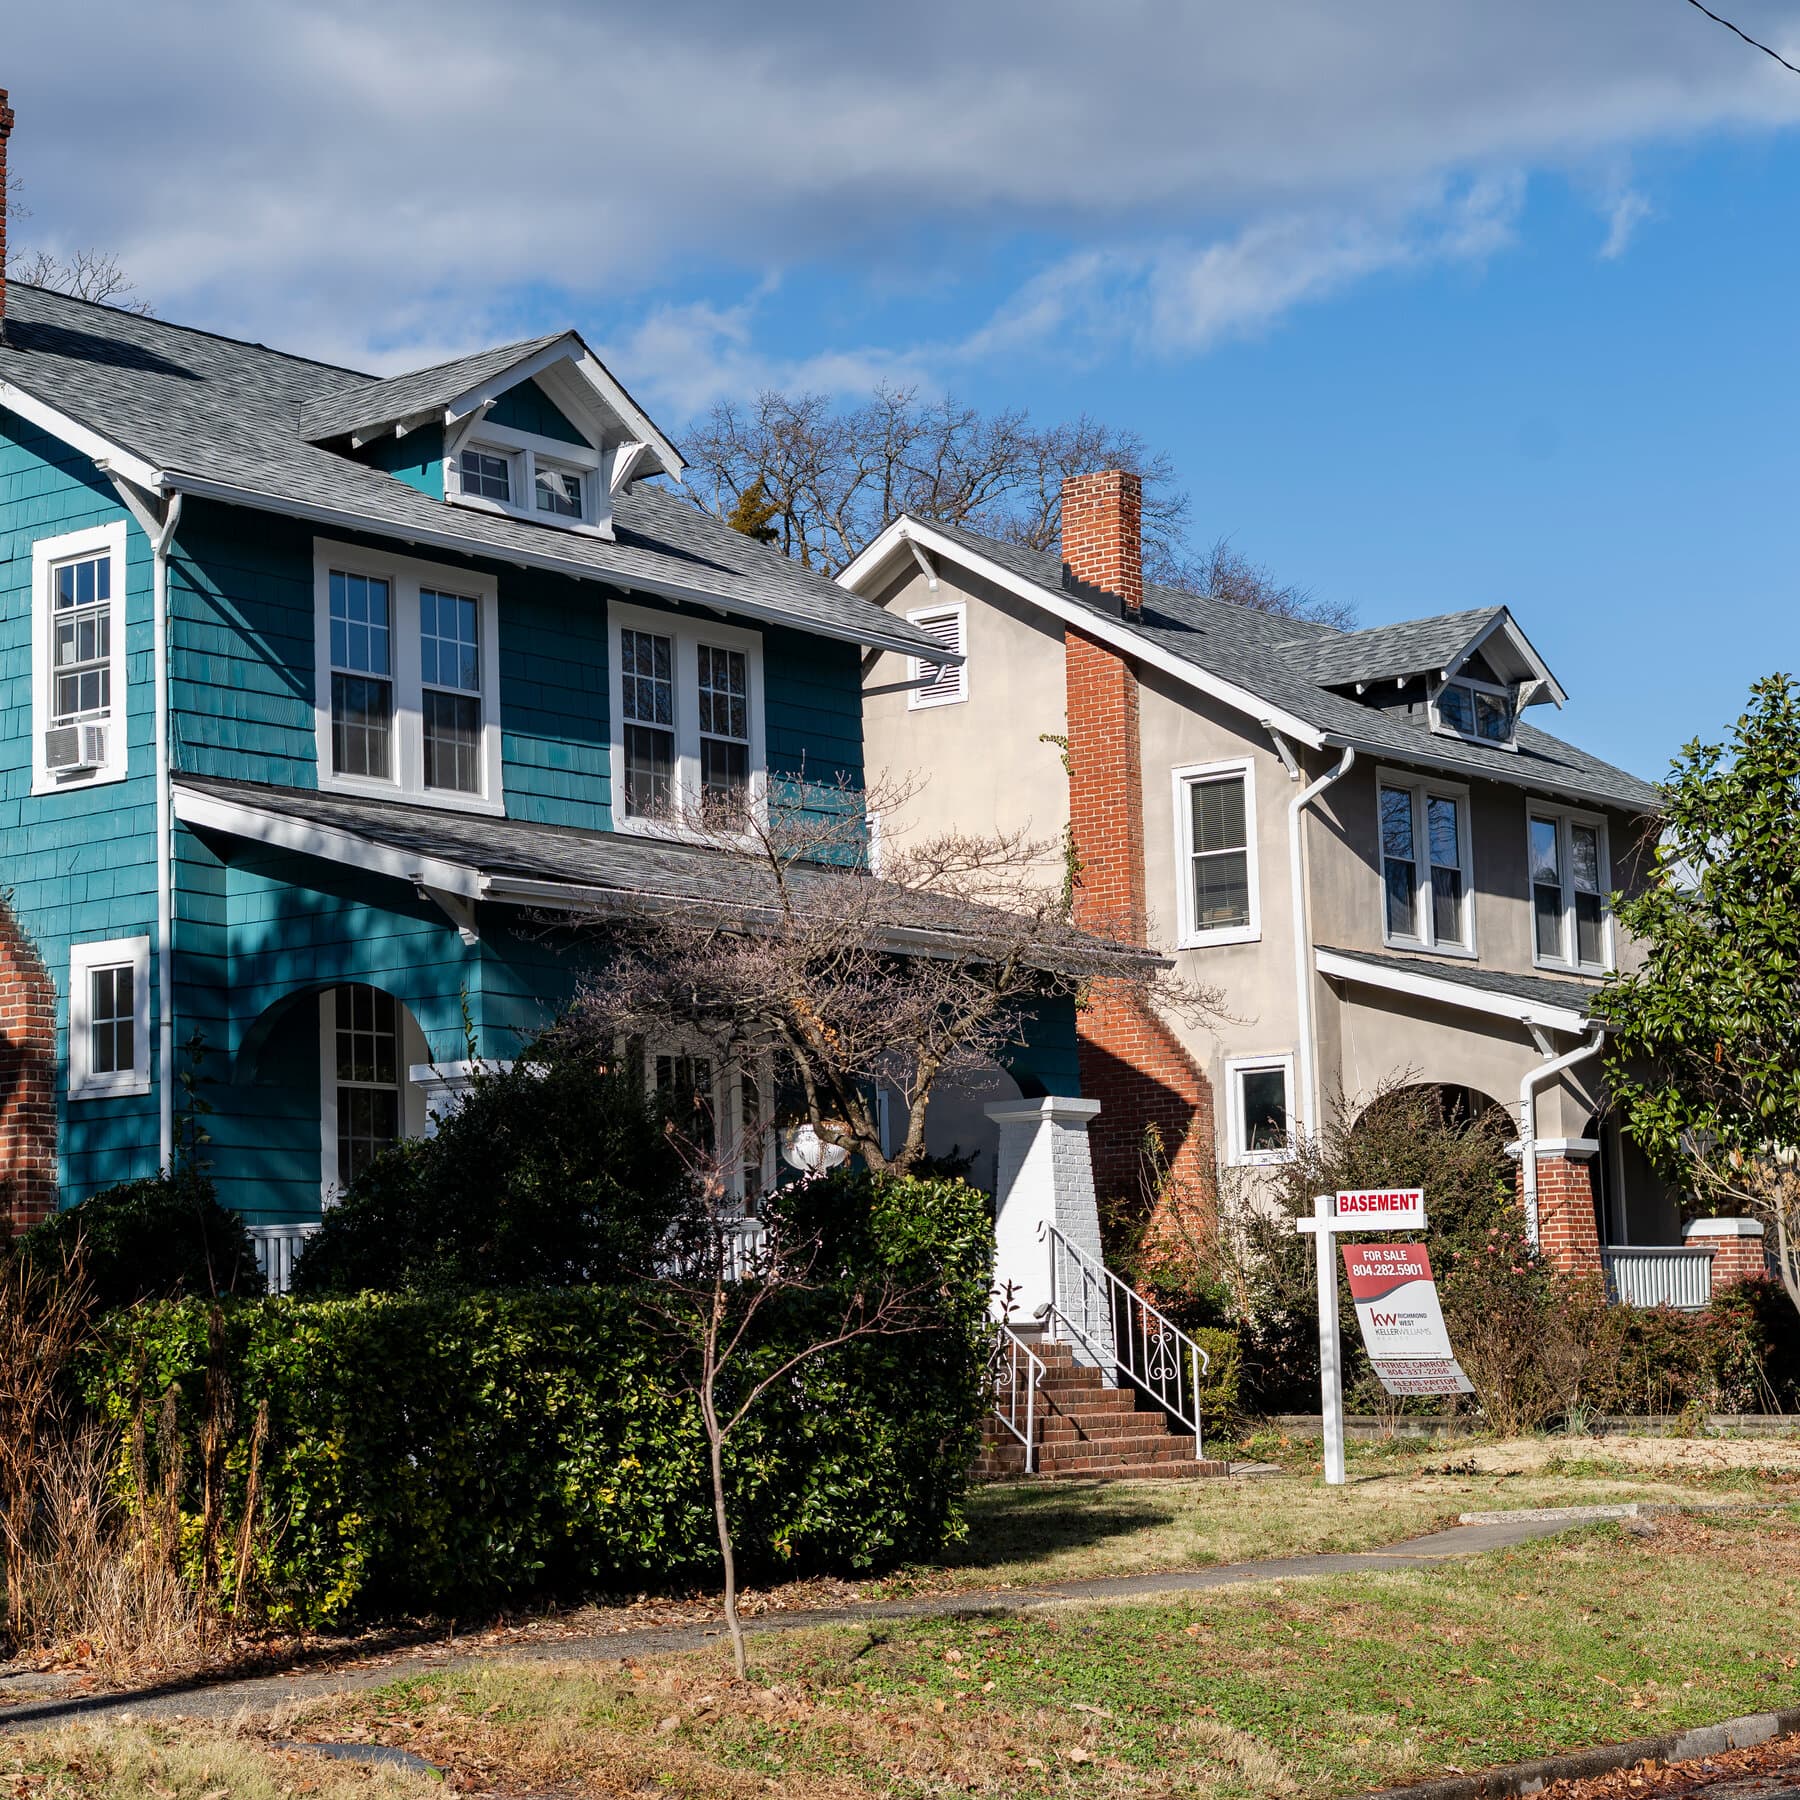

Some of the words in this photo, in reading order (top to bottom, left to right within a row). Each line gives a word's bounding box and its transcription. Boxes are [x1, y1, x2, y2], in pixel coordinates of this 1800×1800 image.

[1340, 1194, 1419, 1212] BASEMENT
[1363, 1250, 1382, 1261] FOR
[1383, 1250, 1408, 1261] SALE
[1352, 1264, 1424, 1277] 804.282.5901
[1376, 1361, 1411, 1369] PATRICE
[1412, 1360, 1454, 1368] CARROLL
